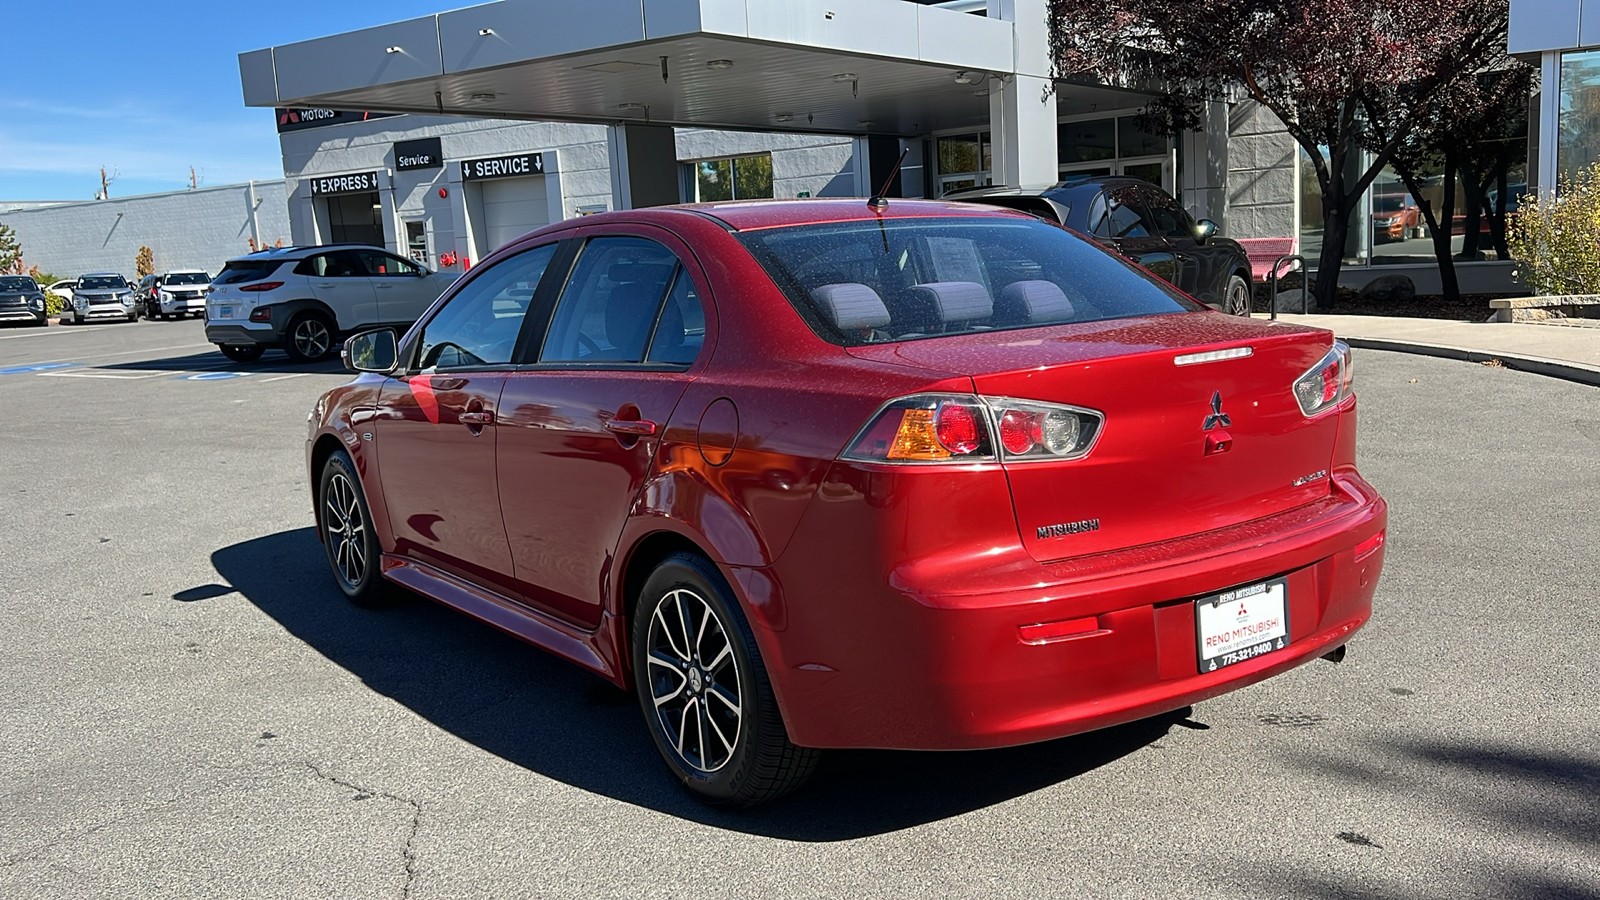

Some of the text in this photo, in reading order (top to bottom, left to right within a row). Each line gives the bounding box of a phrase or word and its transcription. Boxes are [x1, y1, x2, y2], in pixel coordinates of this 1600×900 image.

[301, 109, 335, 122] MOTORS
[398, 154, 430, 168] Service
[475, 157, 530, 177] SERVICE
[320, 175, 369, 194] EXPRESS
[1037, 518, 1100, 539] MITSUBISHI
[1219, 583, 1267, 604] RENO MITSUBISHI
[1206, 617, 1279, 648] RENO MITSUBISHI
[1222, 641, 1272, 666] 775-321-9400
